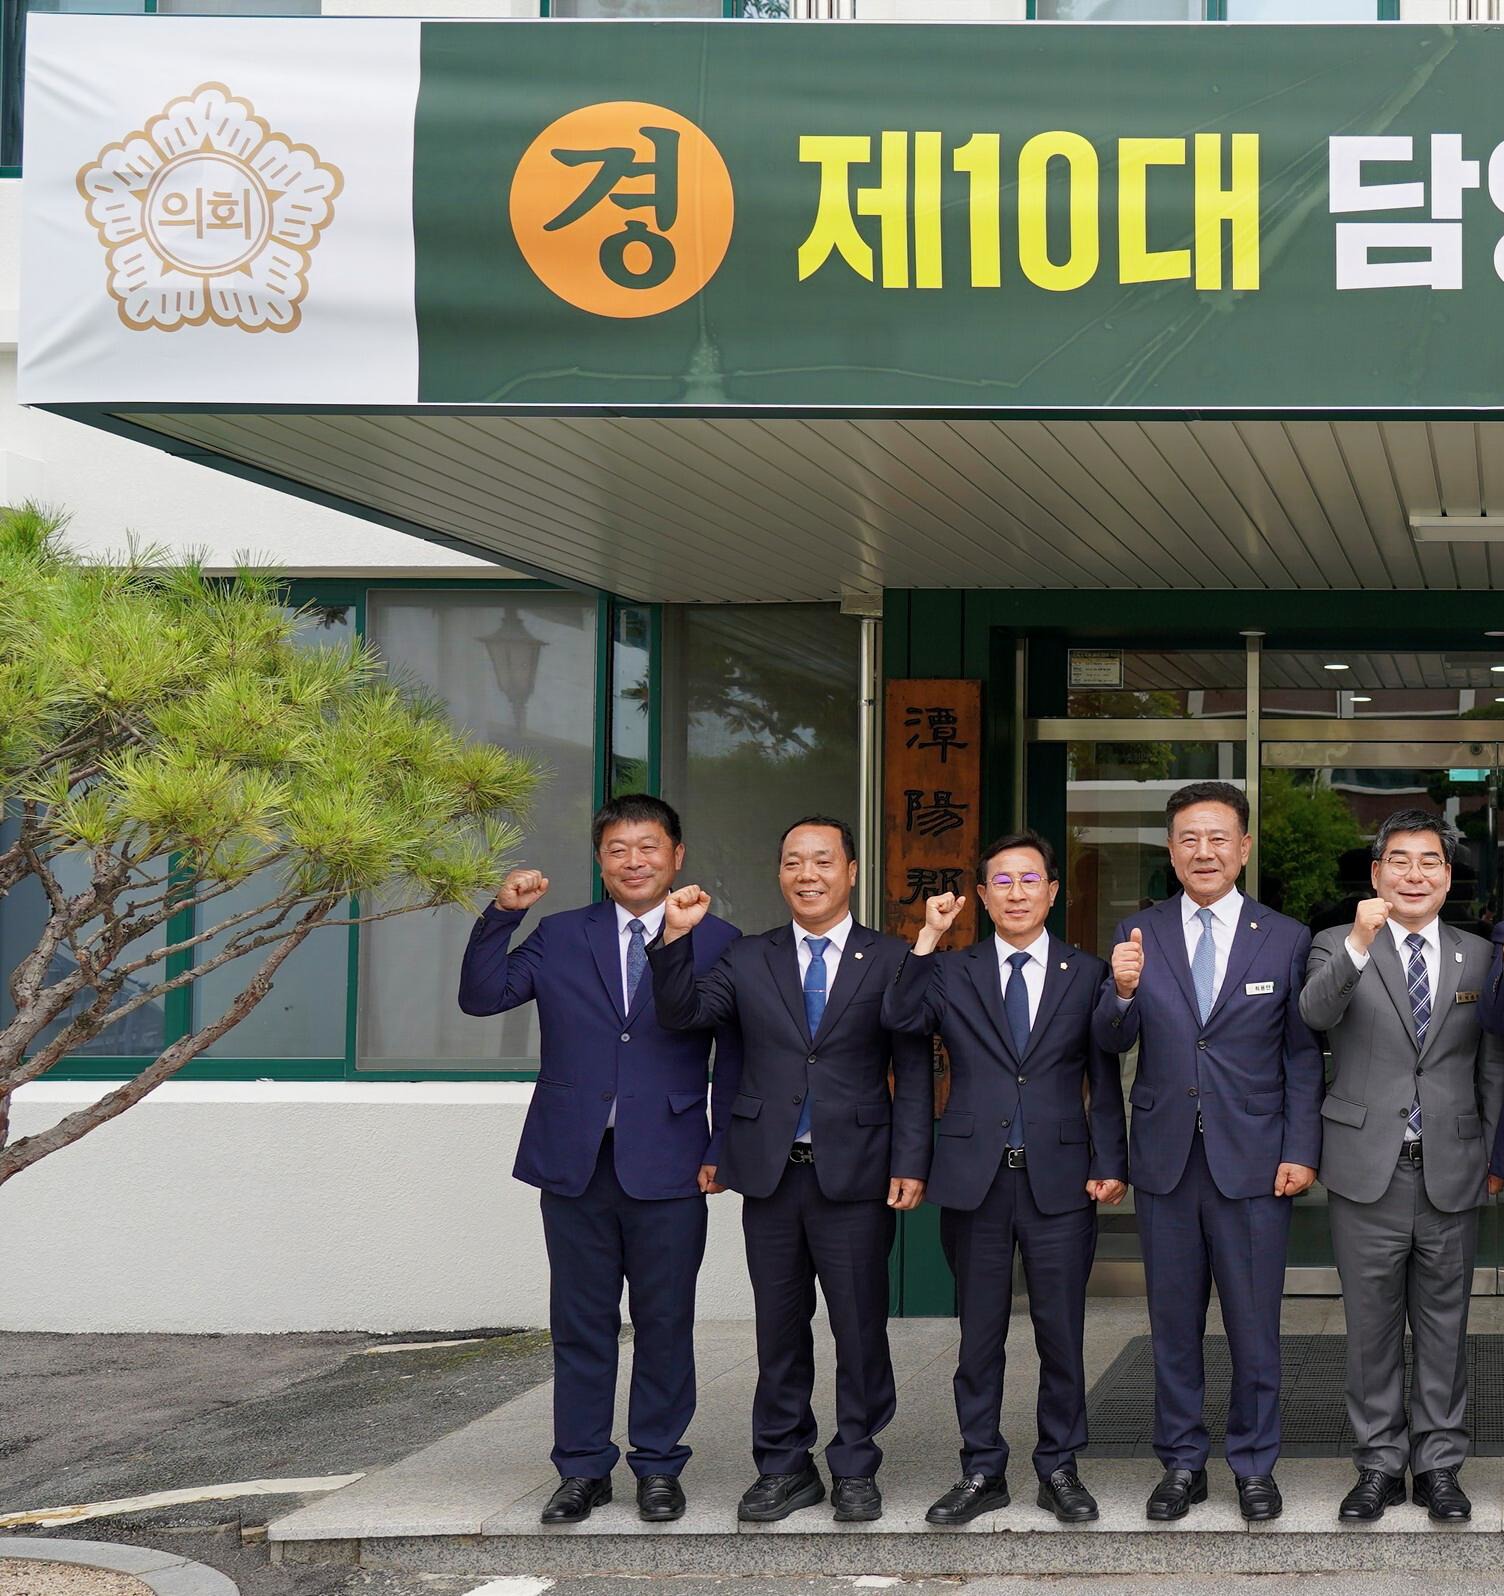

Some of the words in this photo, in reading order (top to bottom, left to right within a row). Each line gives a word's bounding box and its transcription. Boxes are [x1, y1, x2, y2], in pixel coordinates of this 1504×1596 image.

[158, 187, 252, 241] 의회
[543, 125, 681, 290] 경
[798, 130, 1260, 292] 제10대
